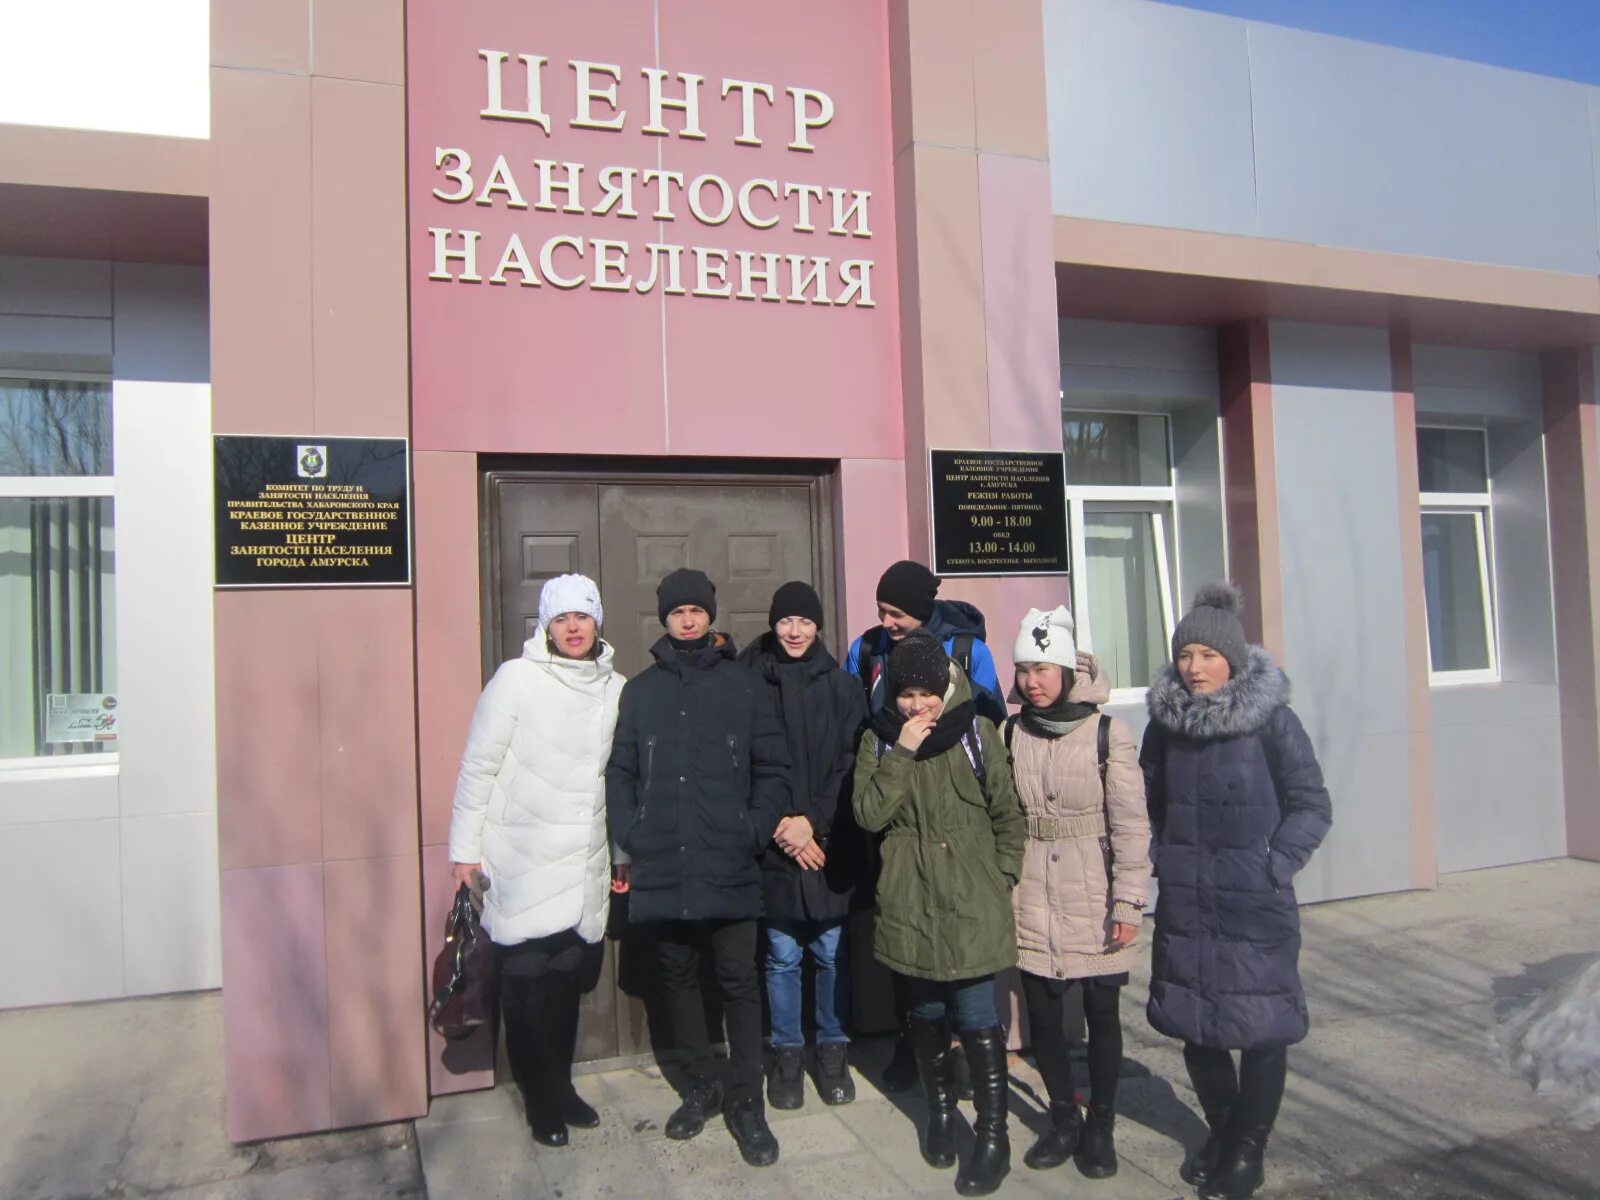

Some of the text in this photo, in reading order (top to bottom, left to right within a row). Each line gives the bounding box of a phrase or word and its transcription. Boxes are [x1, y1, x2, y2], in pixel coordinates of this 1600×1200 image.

[478, 48, 835, 153] ЦЕНТР
[432, 146, 873, 238] ЗАНЯТОСТИ
[427, 227, 875, 308] НАСЕЛЕНИЯ
[287, 512, 397, 520] ГОСУДАРСТВЕННОЕ
[971, 516, 993, 526] 9.00
[1005, 516, 1031, 526] 18.00
[308, 522, 387, 531] УЧРЕЖДЕНИЕ
[286, 534, 335, 545] ЦЕНТР
[231, 546, 392, 554] ЗАНЯТОСТИ НАСЕЛЕНИЯ
[969, 542, 997, 553] 13.00
[1009, 542, 1035, 552] 14.00
[256, 558, 368, 567] ГОРОДА АМУРСКА
